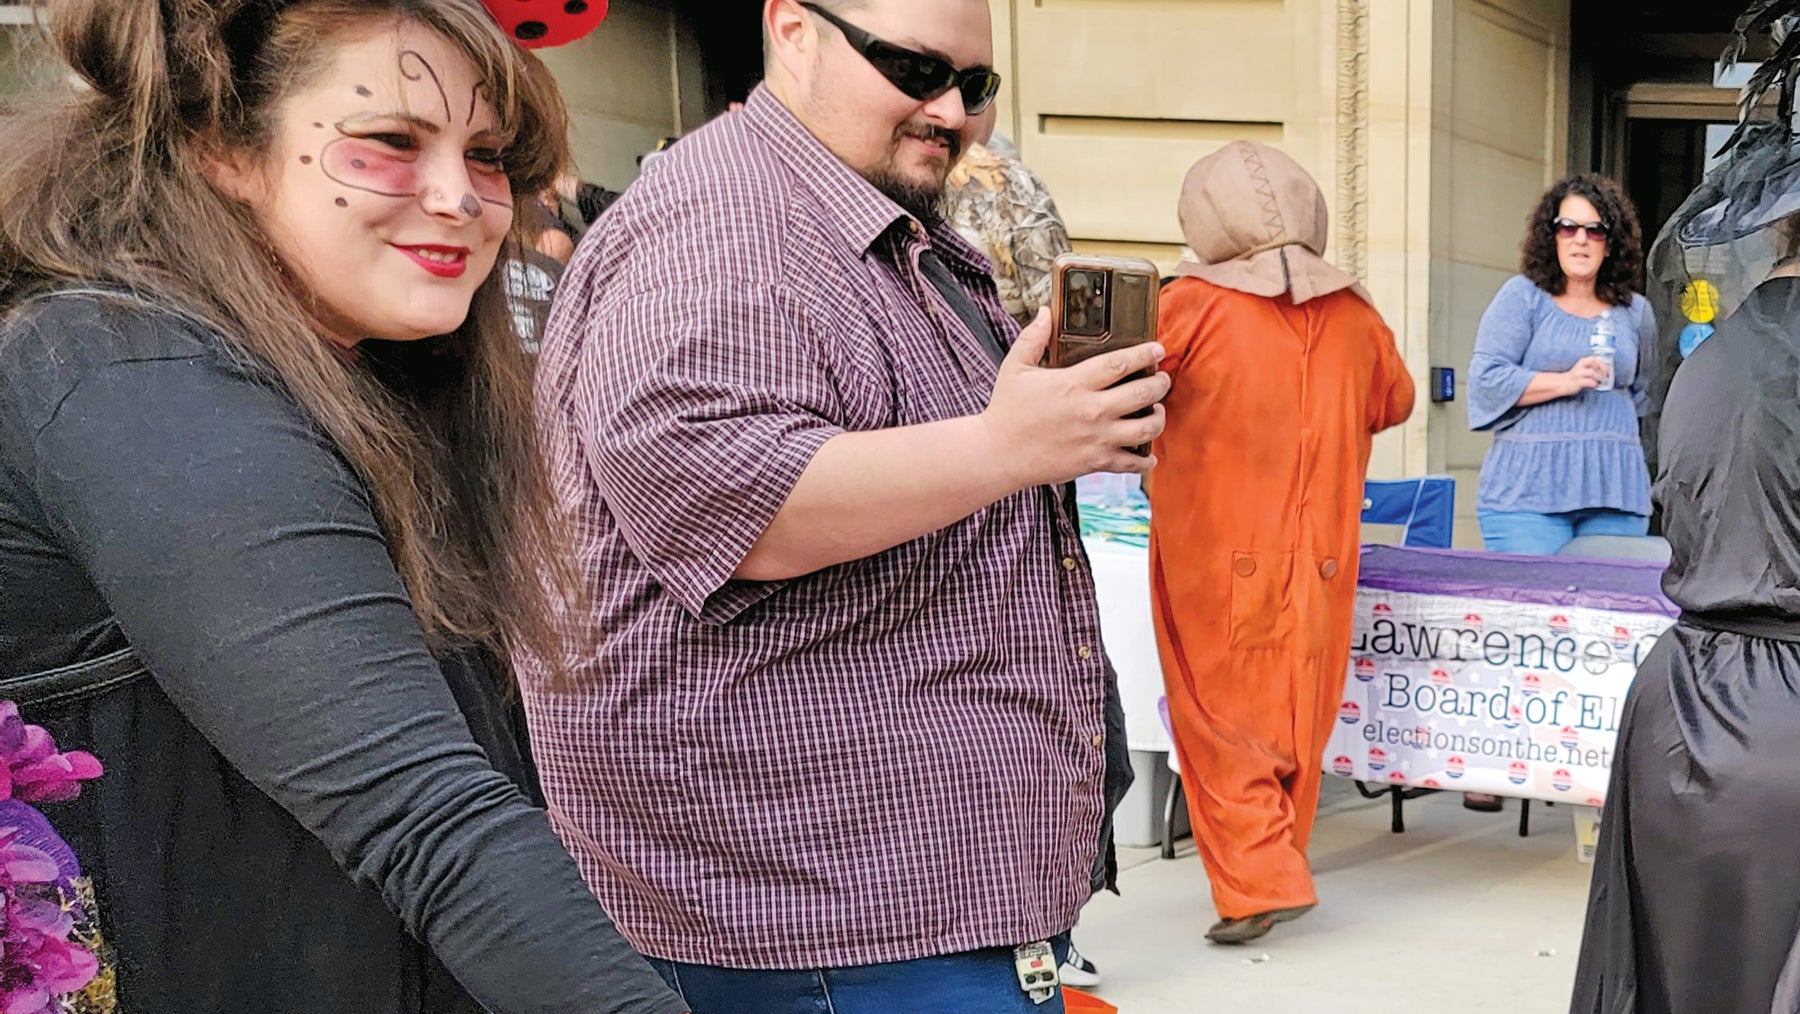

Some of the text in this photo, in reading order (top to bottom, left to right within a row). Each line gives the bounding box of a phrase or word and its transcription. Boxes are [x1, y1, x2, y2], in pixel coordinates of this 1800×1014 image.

[1383, 673, 1511, 722] Board
[1526, 691, 1568, 726] of
[1363, 720, 1611, 769] electionsonthe.net
